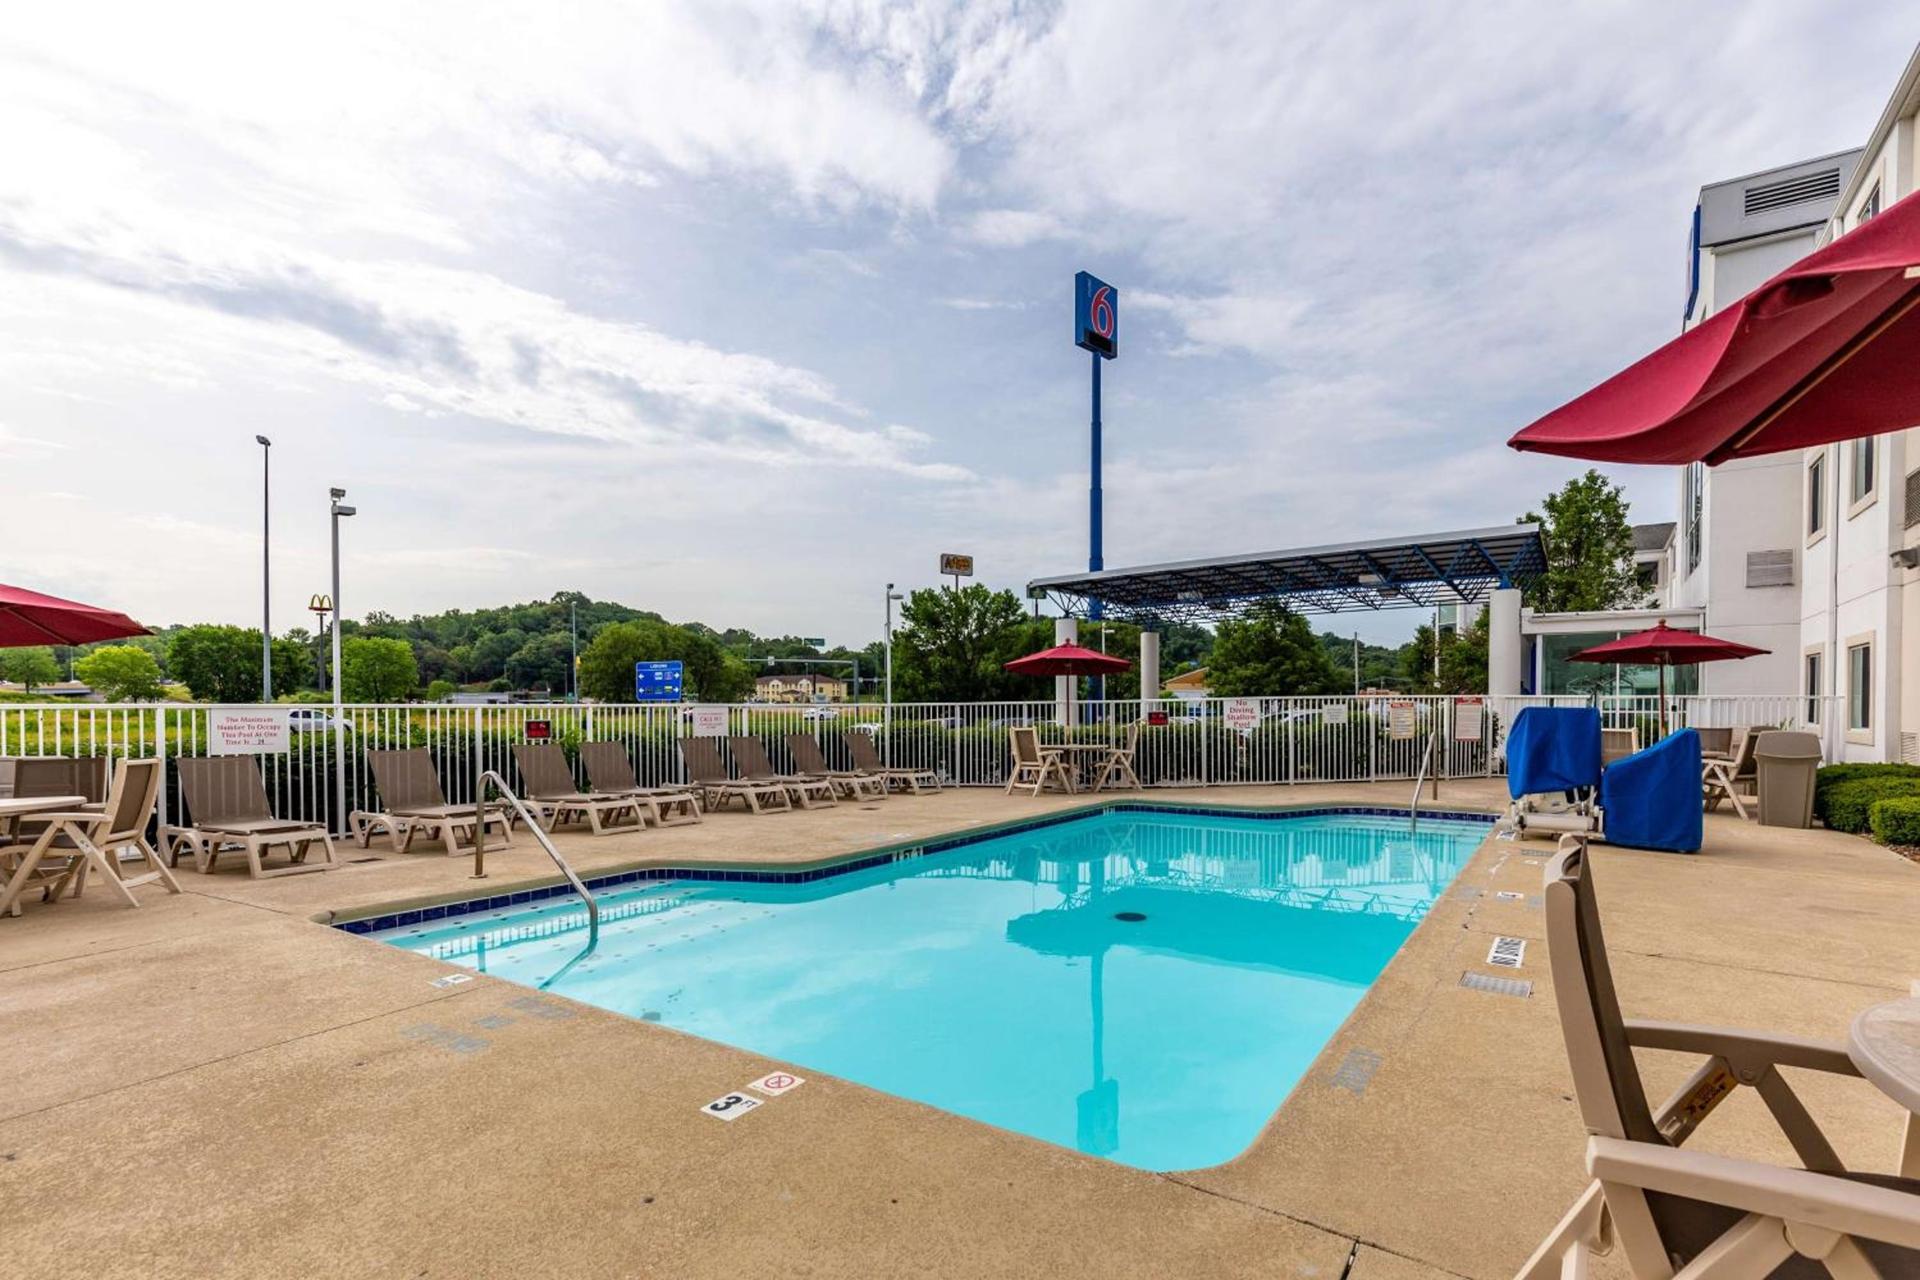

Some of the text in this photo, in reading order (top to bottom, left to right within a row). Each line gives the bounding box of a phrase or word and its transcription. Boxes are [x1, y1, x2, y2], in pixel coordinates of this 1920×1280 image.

[1091, 286, 1114, 339] 6
[1229, 707, 1255, 715] Diving
[709, 1095, 743, 1111] 3
[741, 1100, 758, 1109] FT
